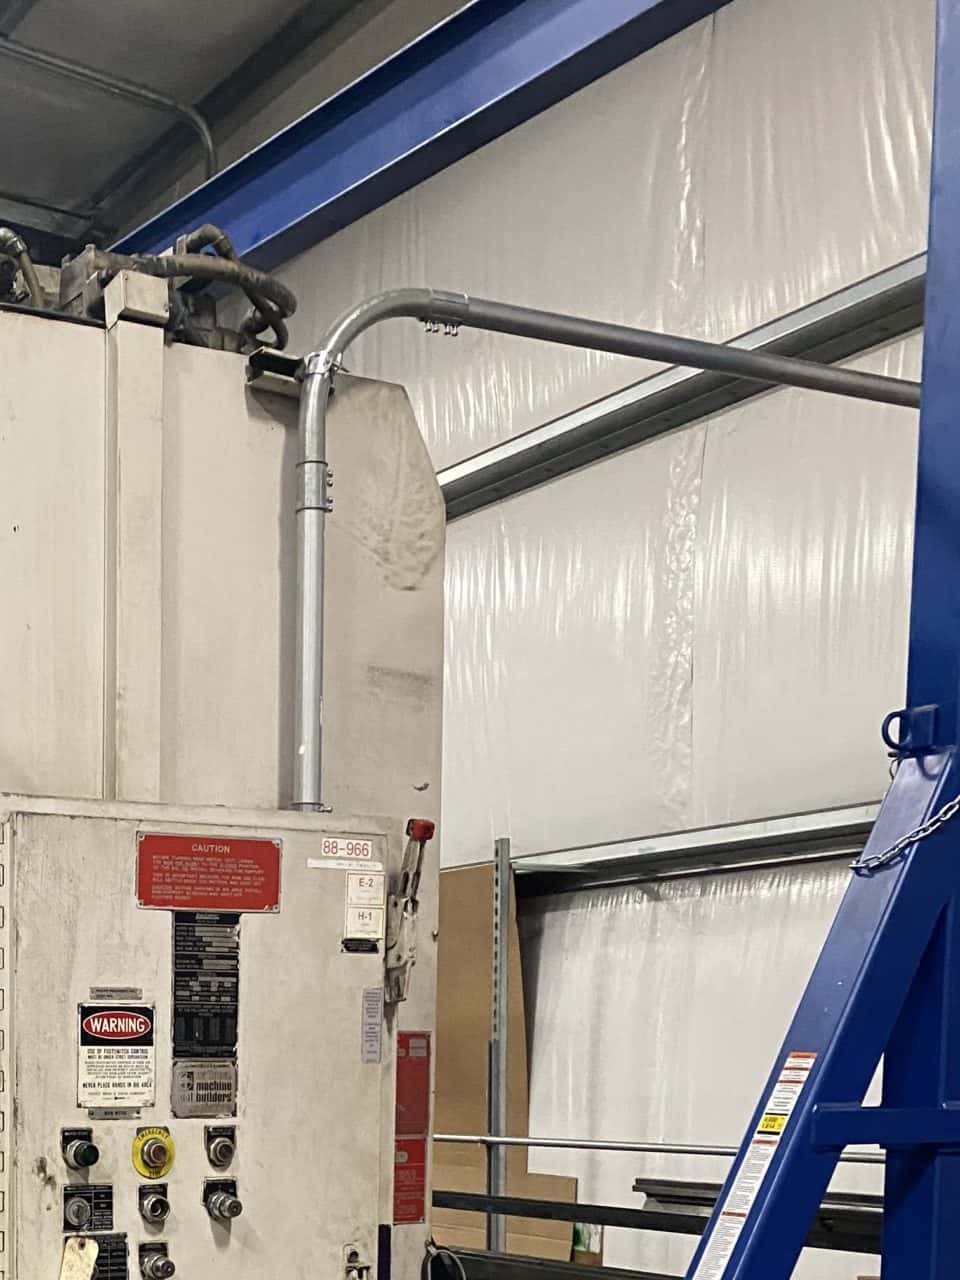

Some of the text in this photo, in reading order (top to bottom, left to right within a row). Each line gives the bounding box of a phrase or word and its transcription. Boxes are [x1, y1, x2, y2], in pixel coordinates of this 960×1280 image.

[191, 843, 230, 854] CAUTION
[323, 840, 369, 857] 88-966
[359, 878, 374, 888] E-2
[358, 911, 372, 921] H-1
[90, 1017, 145, 1033] WARNING
[196, 1080, 232, 1091] machine
